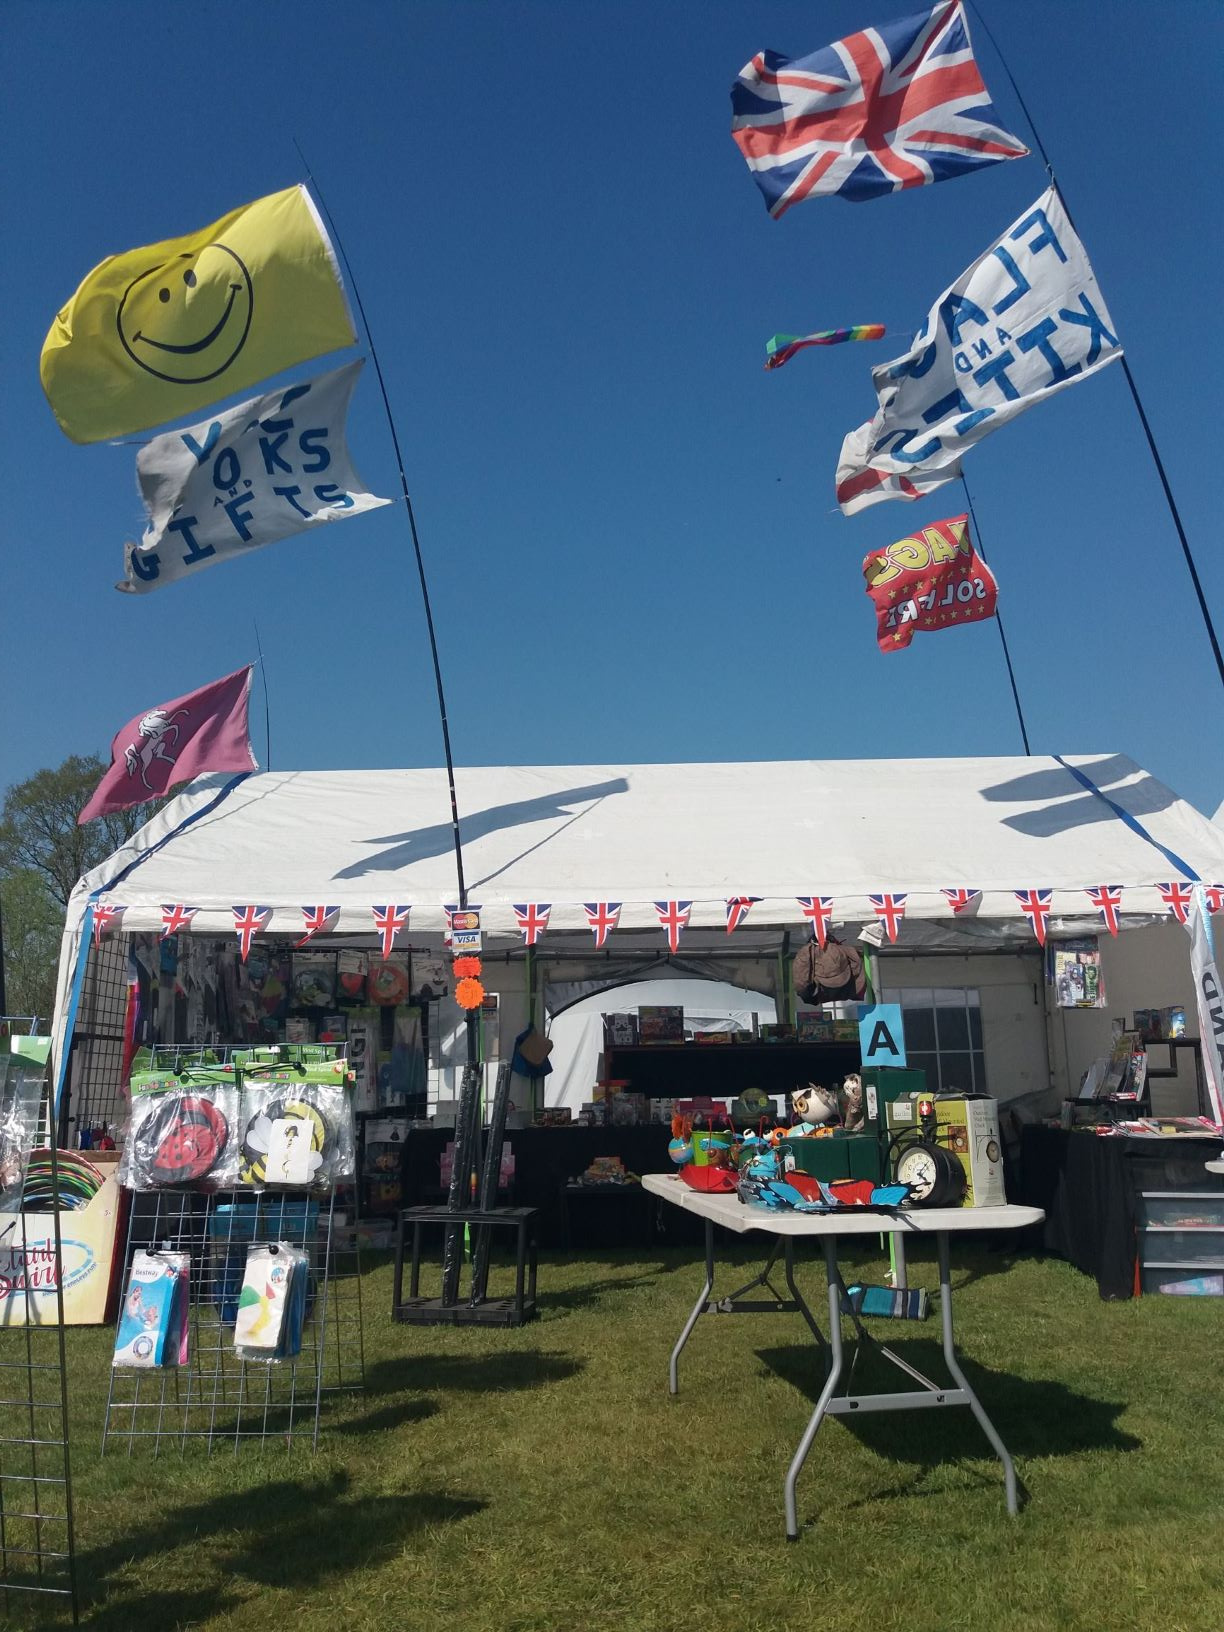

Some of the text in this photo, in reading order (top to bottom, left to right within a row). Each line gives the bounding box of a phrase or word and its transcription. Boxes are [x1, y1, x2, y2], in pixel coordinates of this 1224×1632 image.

[131, 483, 355, 581] GIFTS
[457, 935, 476, 944] VISA
[867, 1020, 900, 1057] A
